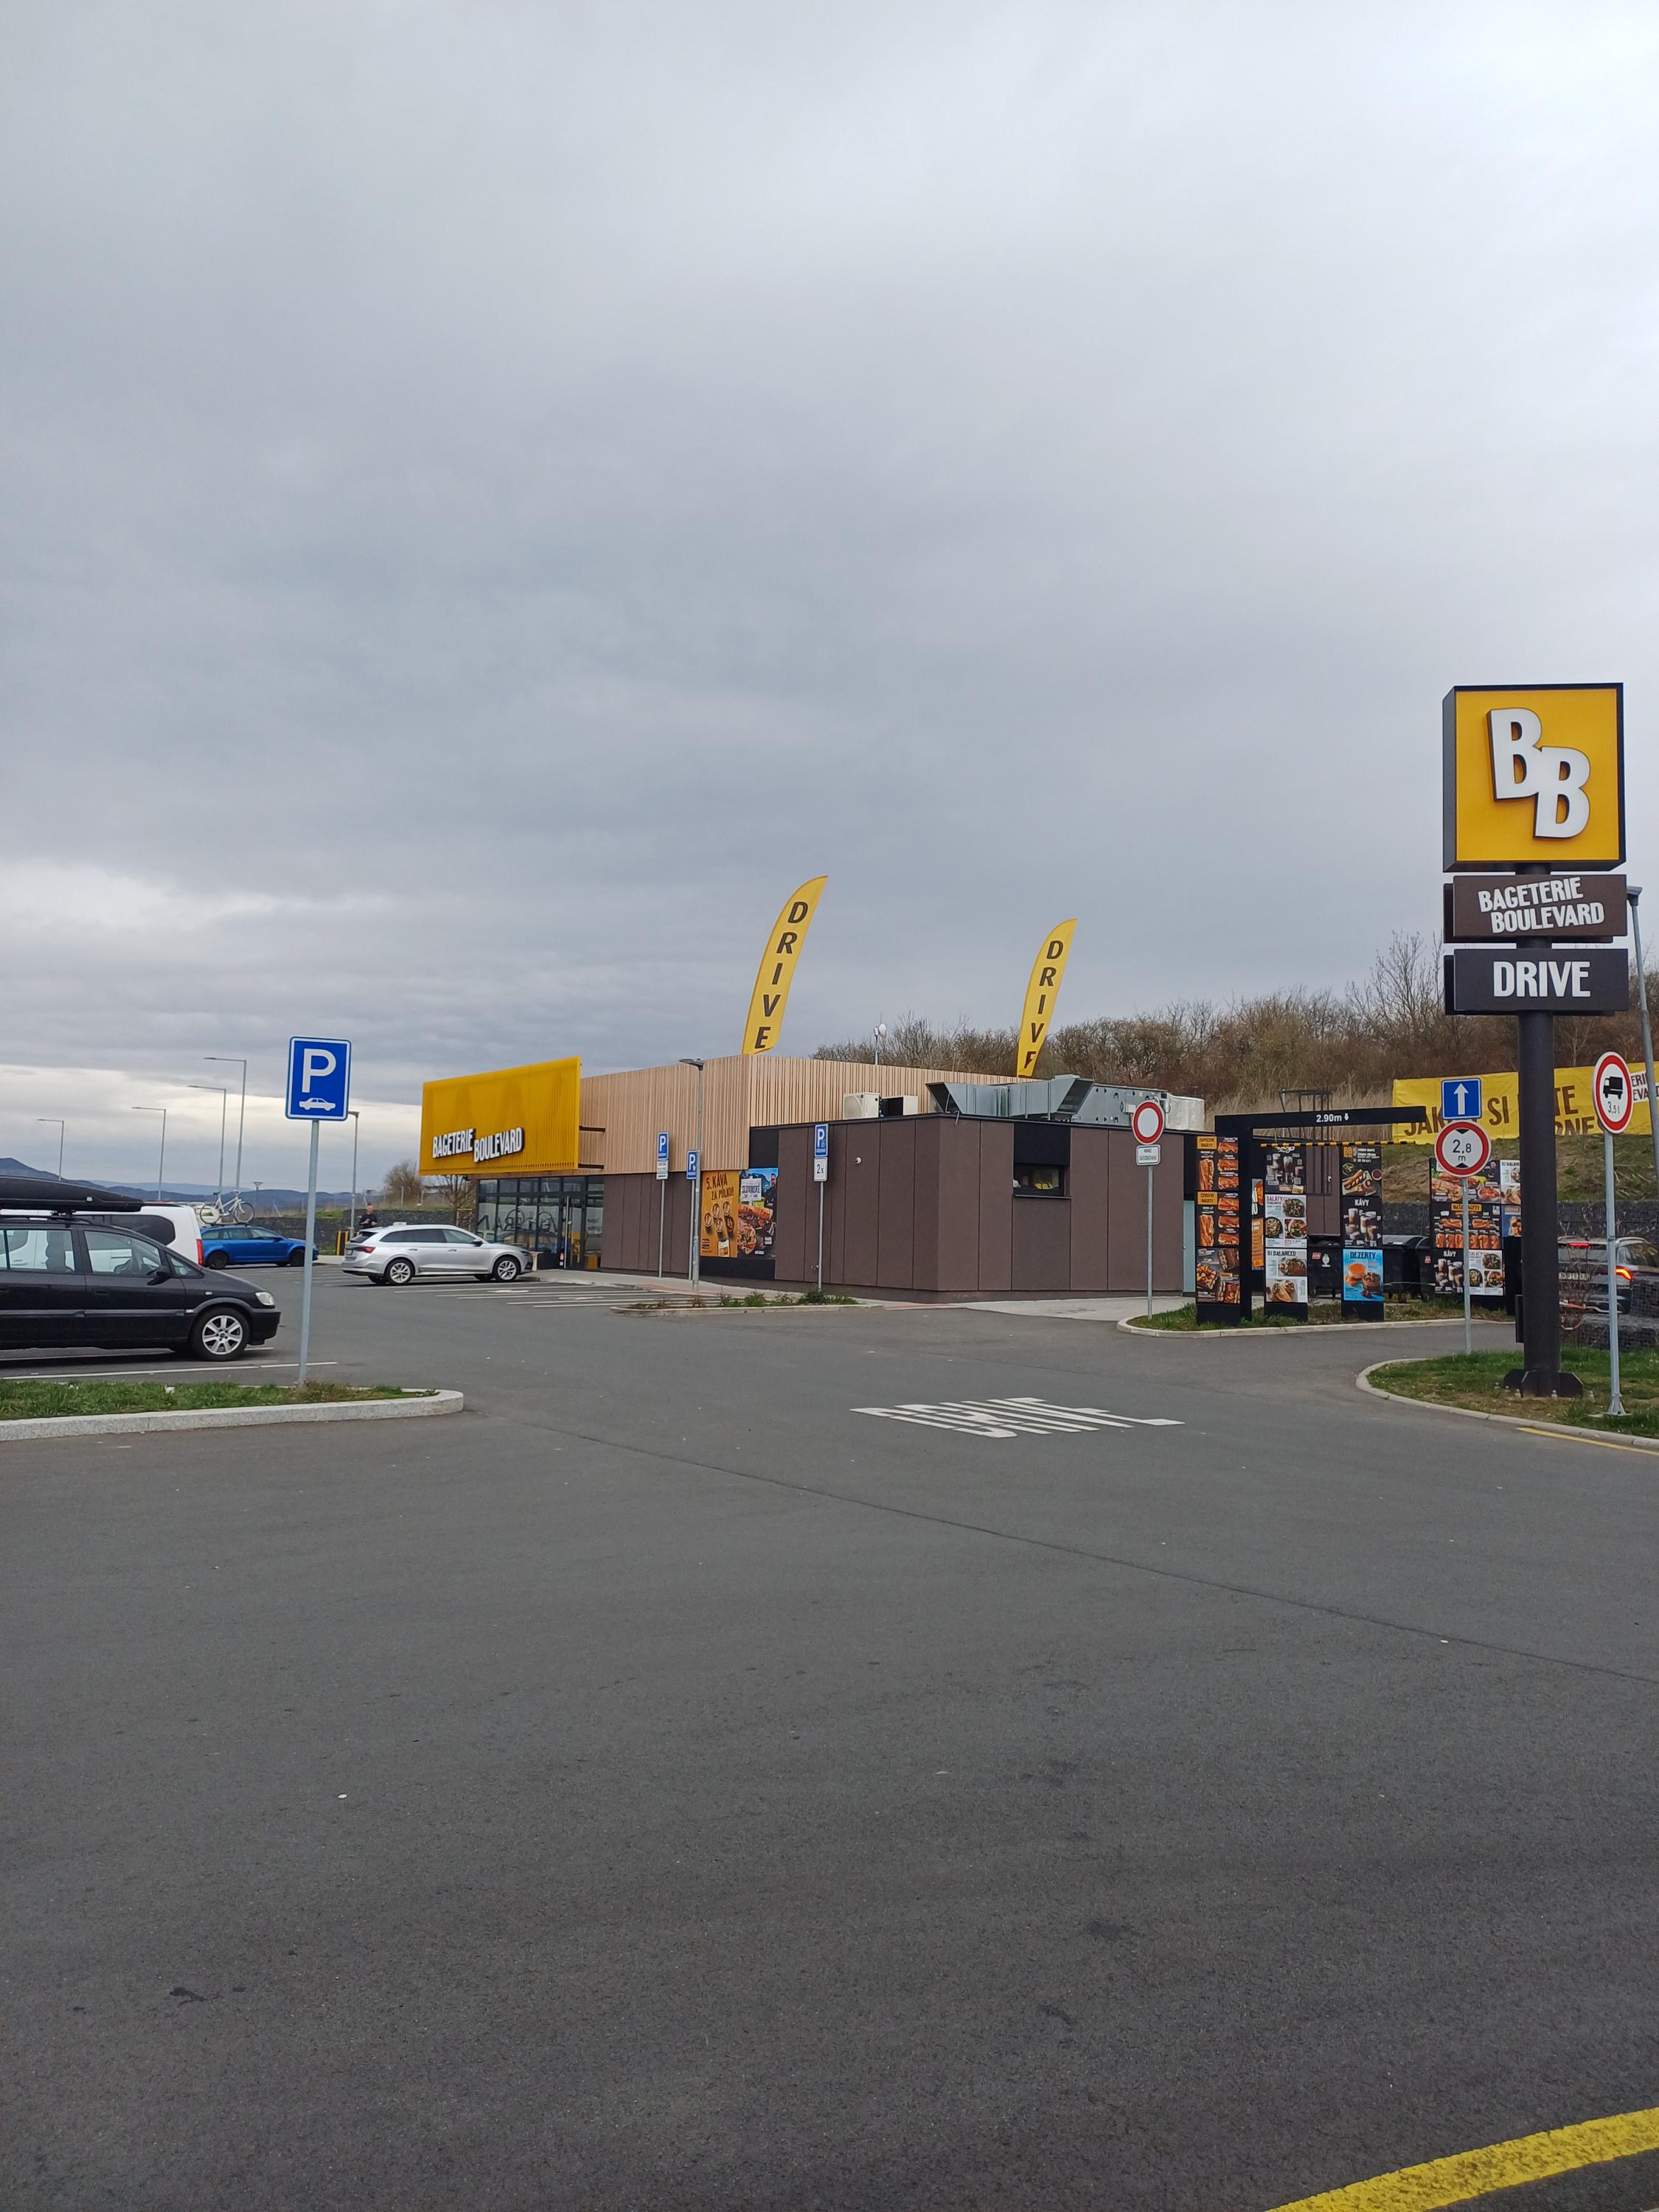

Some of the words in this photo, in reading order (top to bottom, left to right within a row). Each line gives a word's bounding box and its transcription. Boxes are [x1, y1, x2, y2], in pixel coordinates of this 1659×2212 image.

[1487, 707, 1591, 839] BB
[1478, 877, 1584, 913] BAGETERIE
[1490, 902, 1605, 933] BOULEVARD
[754, 901, 809, 1049] DRIVE
[1493, 961, 1591, 998] DRIVE
[302, 1048, 336, 1093] P
[1316, 1113, 1342, 1123] 2.90m
[1487, 1096, 1510, 1126] SI
[432, 1128, 475, 1159] BAGETERIE
[473, 1127, 524, 1163] BOULEVARD
[659, 1135, 666, 1152] P
[817, 1128, 825, 1148] P
[1453, 1139, 1472, 1154] 2,8
[689, 1154, 695, 1170] P
[712, 1172, 728, 1188] KÁVA
